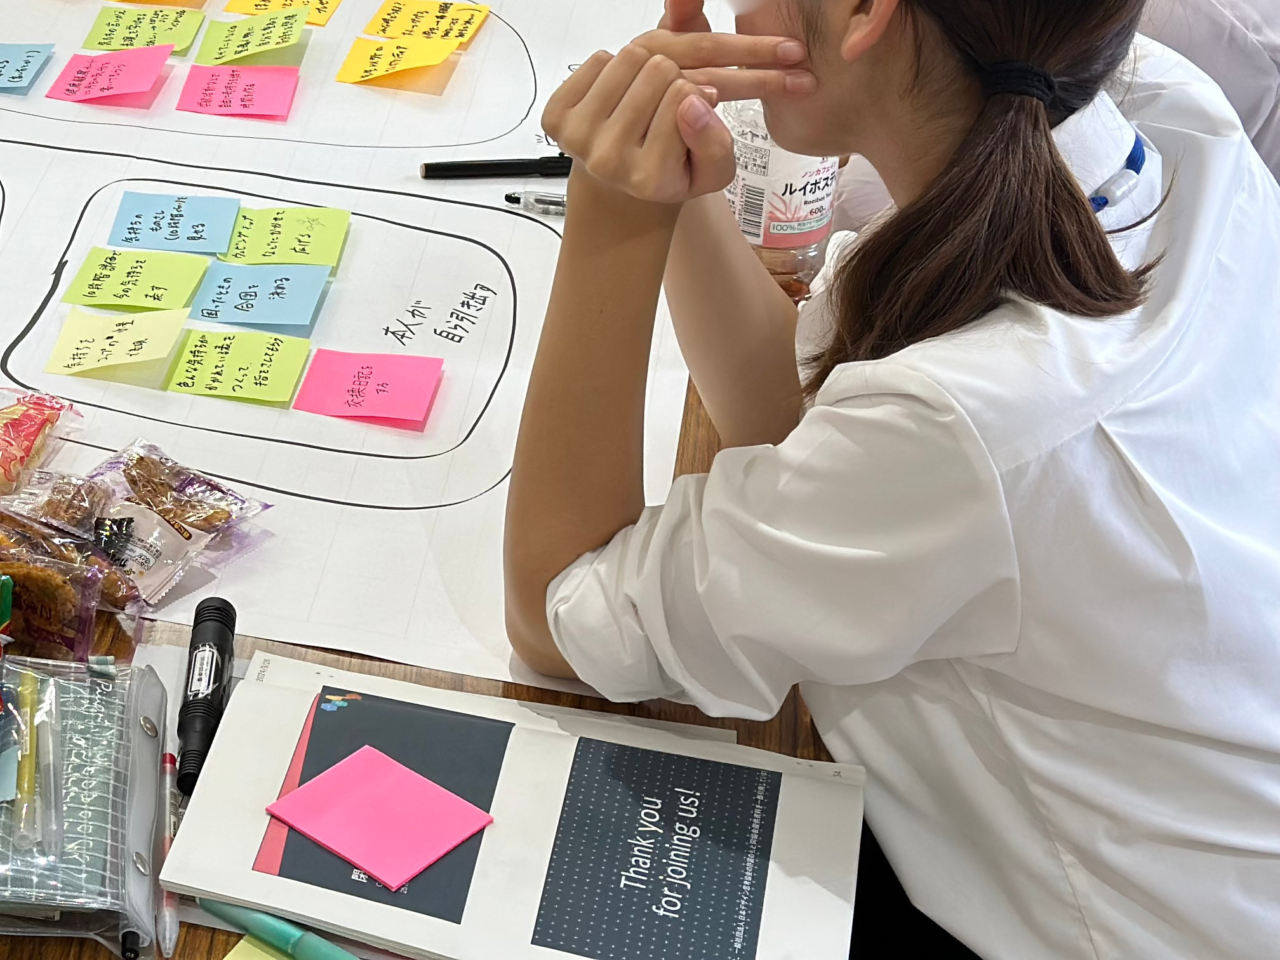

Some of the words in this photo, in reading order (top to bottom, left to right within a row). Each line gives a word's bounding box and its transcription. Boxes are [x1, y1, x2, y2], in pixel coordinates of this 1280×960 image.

[122, 214, 142, 243] 気持ちの
[149, 211, 165, 232] ものさし
[187, 224, 206, 240] 見せる
[291, 234, 311, 254] 広げる
[113, 260, 146, 298] 今の気持ちを
[145, 286, 167, 301] 表す
[269, 278, 290, 299] 決める
[201, 278, 232, 318] 困ったときの
[382, 300, 432, 346] 本人が
[63, 339, 95, 368] 気持ちを
[345, 366, 372, 407] 交換日記を
[376, 383, 389, 394] する
[674, 787, 702, 819] us!
[620, 833, 656, 890] Thank
[639, 796, 665, 835] you
[659, 823, 702, 889] joining
[652, 886, 680, 918] for
